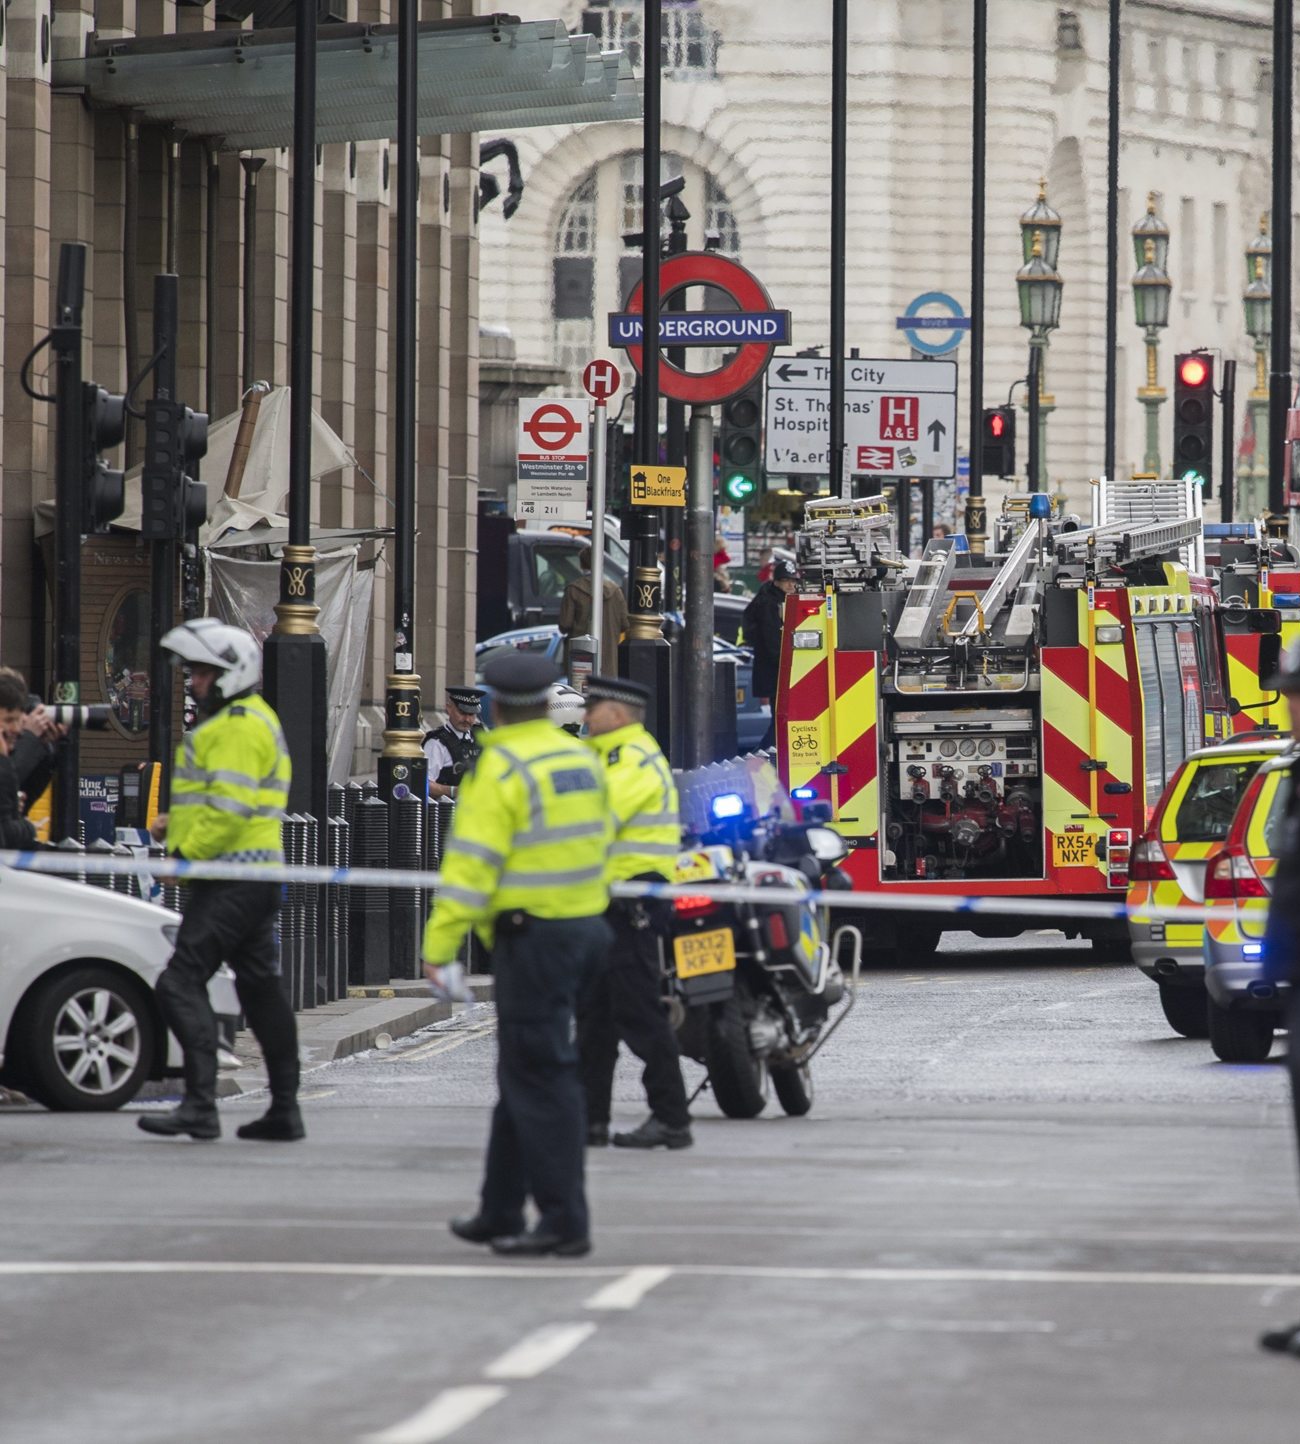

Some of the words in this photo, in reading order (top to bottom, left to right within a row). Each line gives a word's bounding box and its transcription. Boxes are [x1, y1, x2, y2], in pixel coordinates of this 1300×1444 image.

[589, 365, 612, 394] H
[851, 367, 886, 385] City
[775, 397, 799, 412] St.
[888, 399, 911, 426] H
[774, 417, 831, 434] Hospit
[521, 463, 563, 471] Westminster
[657, 473, 671, 484] One
[647, 486, 682, 498] Blackfriars
[545, 506, 558, 514] 211
[791, 725, 818, 733] Cyclists
[1057, 835, 1094, 849] RX54
[1062, 849, 1089, 862] NXF
